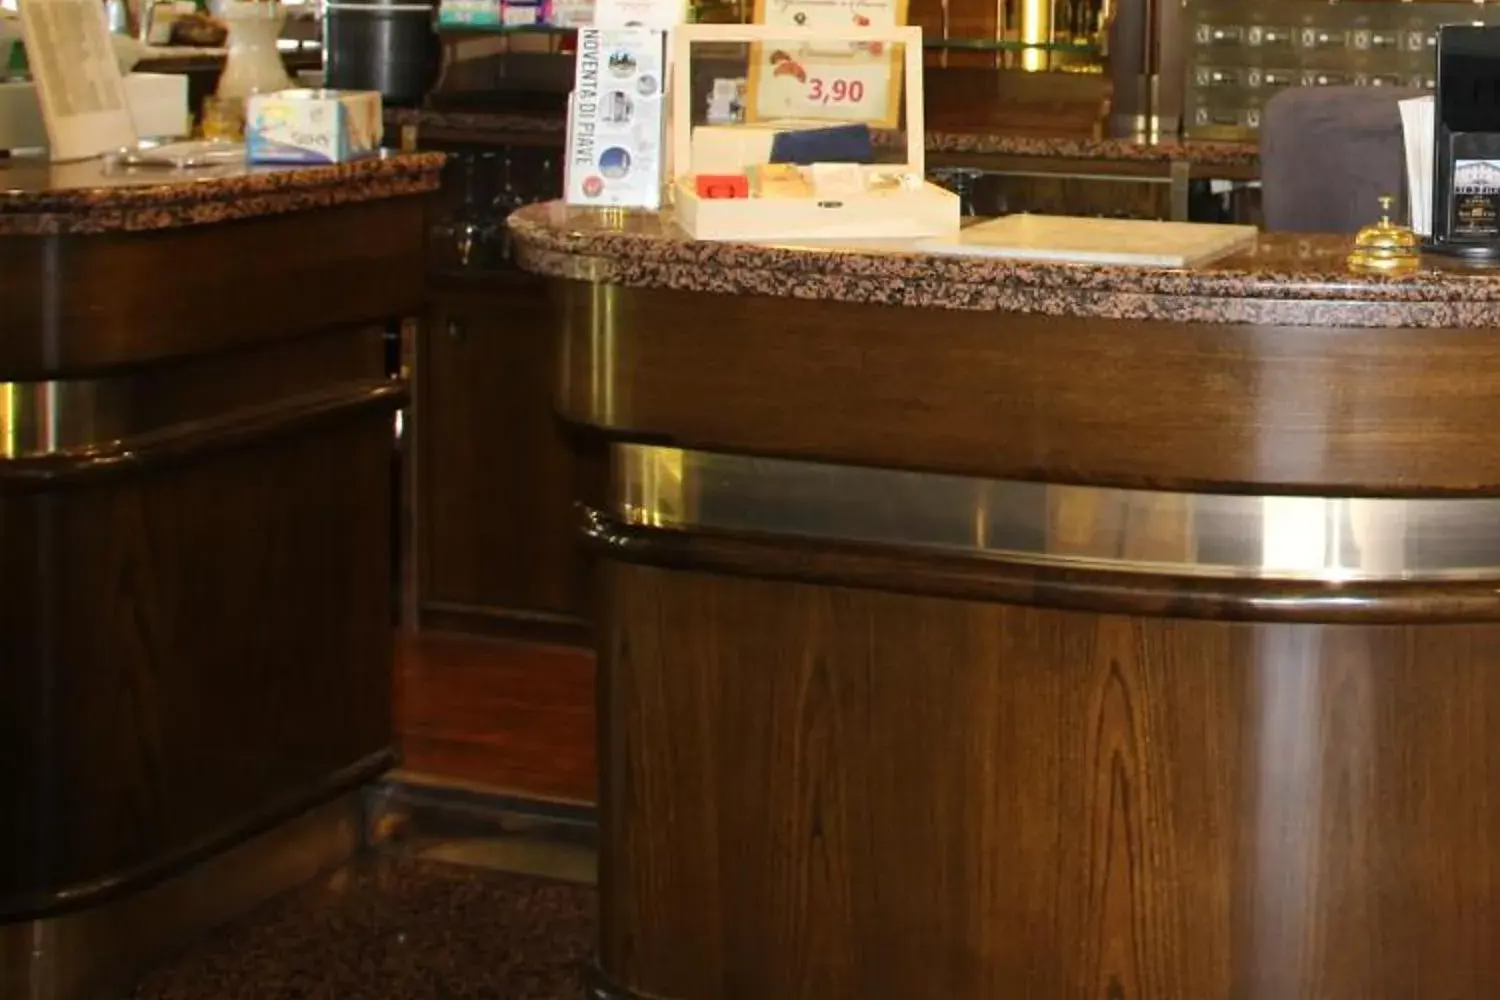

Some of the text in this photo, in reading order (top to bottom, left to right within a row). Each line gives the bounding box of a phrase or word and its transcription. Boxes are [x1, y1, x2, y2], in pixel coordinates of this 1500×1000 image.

[575, 29, 599, 166] NOVENTA DI PIAVE
[807, 78, 865, 104] 3,90
